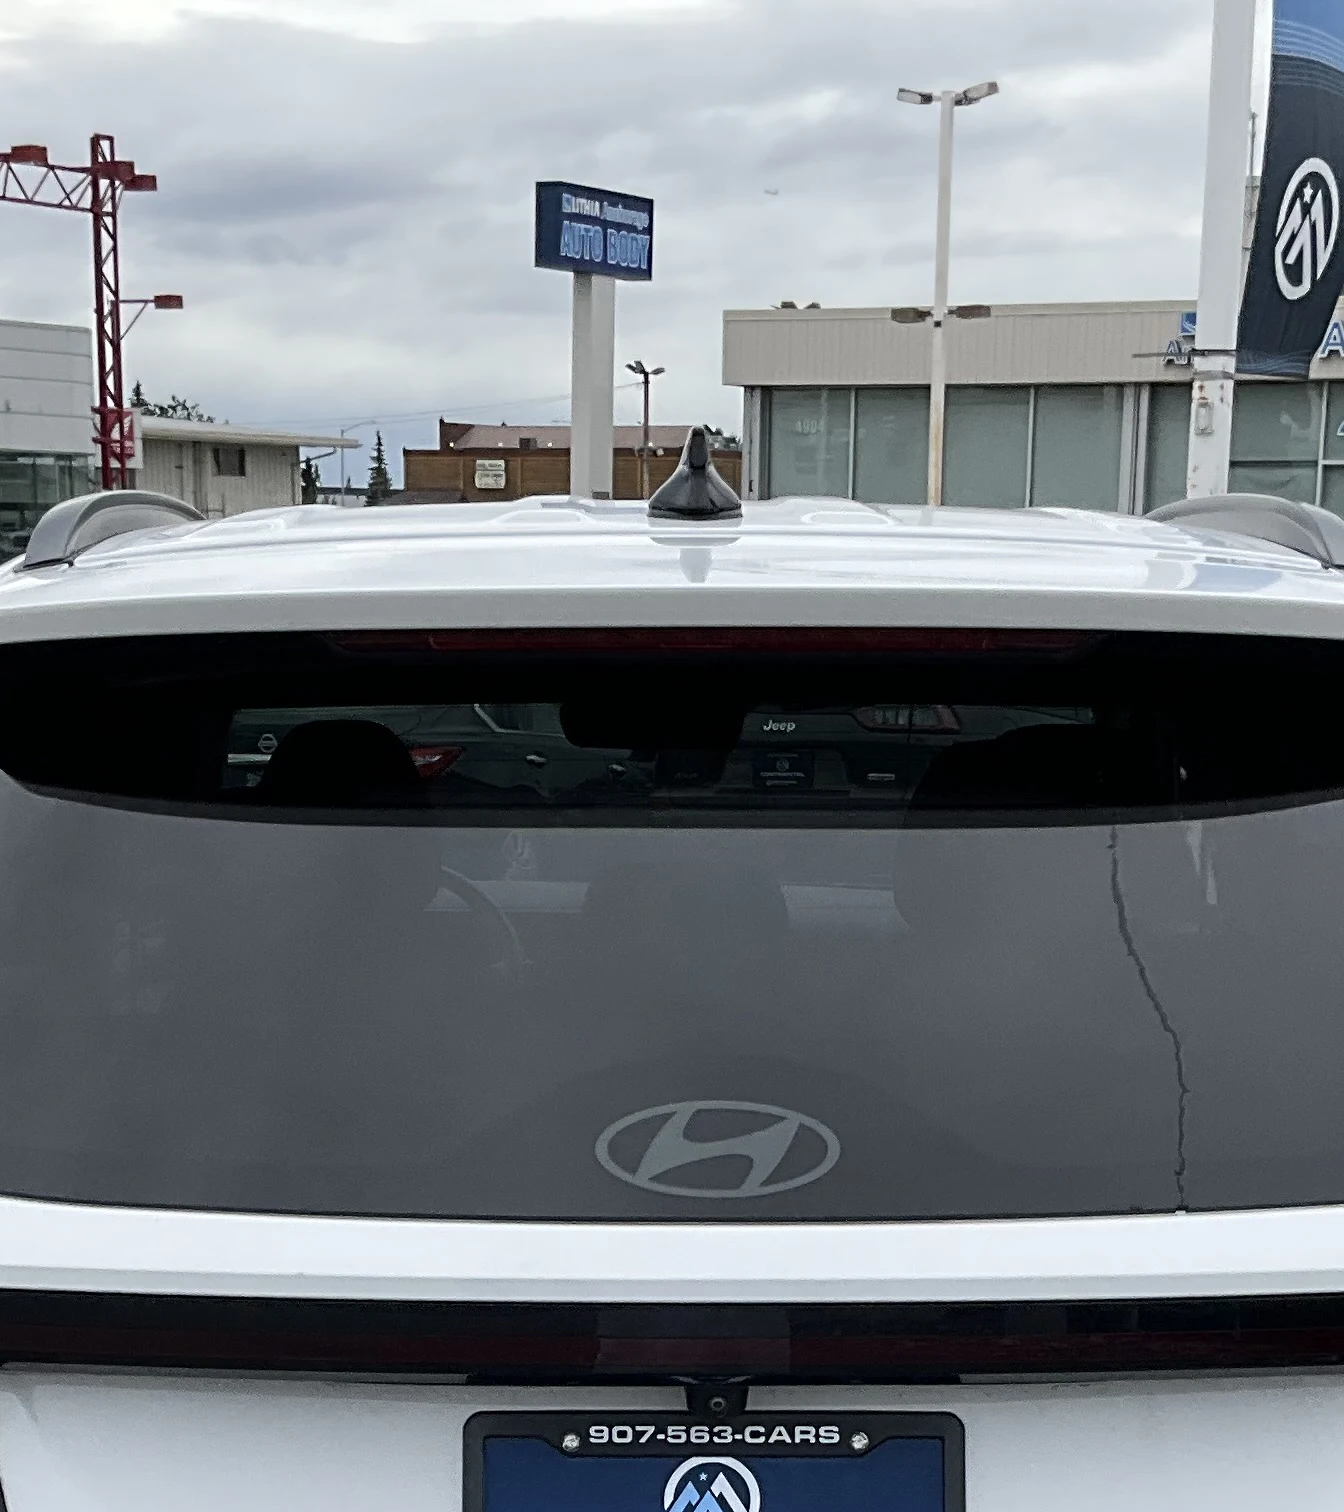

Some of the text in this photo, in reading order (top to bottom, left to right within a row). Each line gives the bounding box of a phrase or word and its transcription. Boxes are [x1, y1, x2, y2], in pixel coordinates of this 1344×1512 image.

[560, 220, 651, 270] AUTO BODY
[763, 719, 796, 734] Jeep
[588, 1425, 840, 1445] 907-563-CARS
